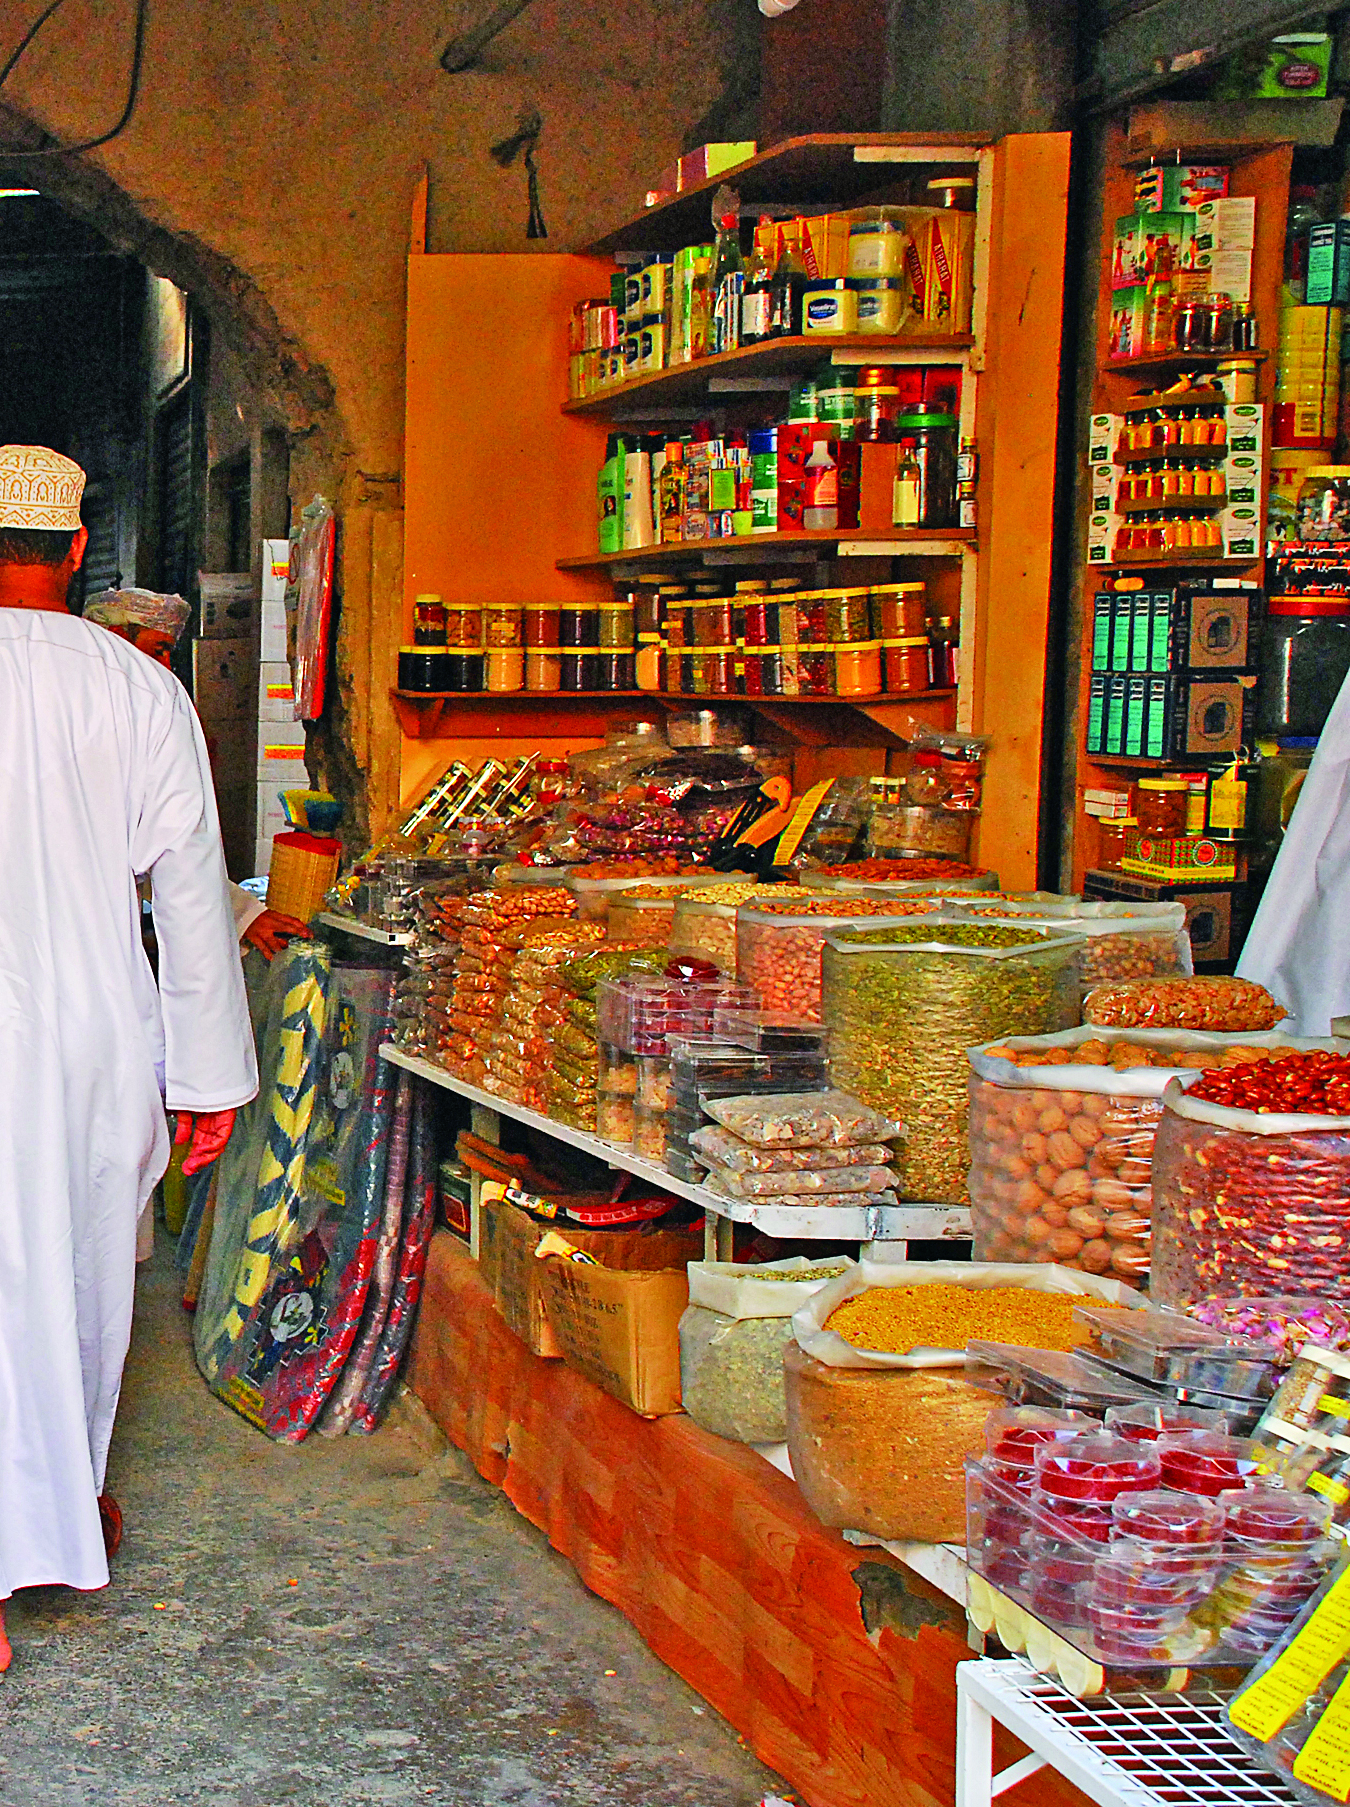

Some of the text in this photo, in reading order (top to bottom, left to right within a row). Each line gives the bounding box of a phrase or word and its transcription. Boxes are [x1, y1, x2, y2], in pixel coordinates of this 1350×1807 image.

[1232, 1712, 1266, 1735] CINNAMON
[1307, 1753, 1346, 1775] CHILLY
[1298, 1769, 1342, 1795] CINNAMON
